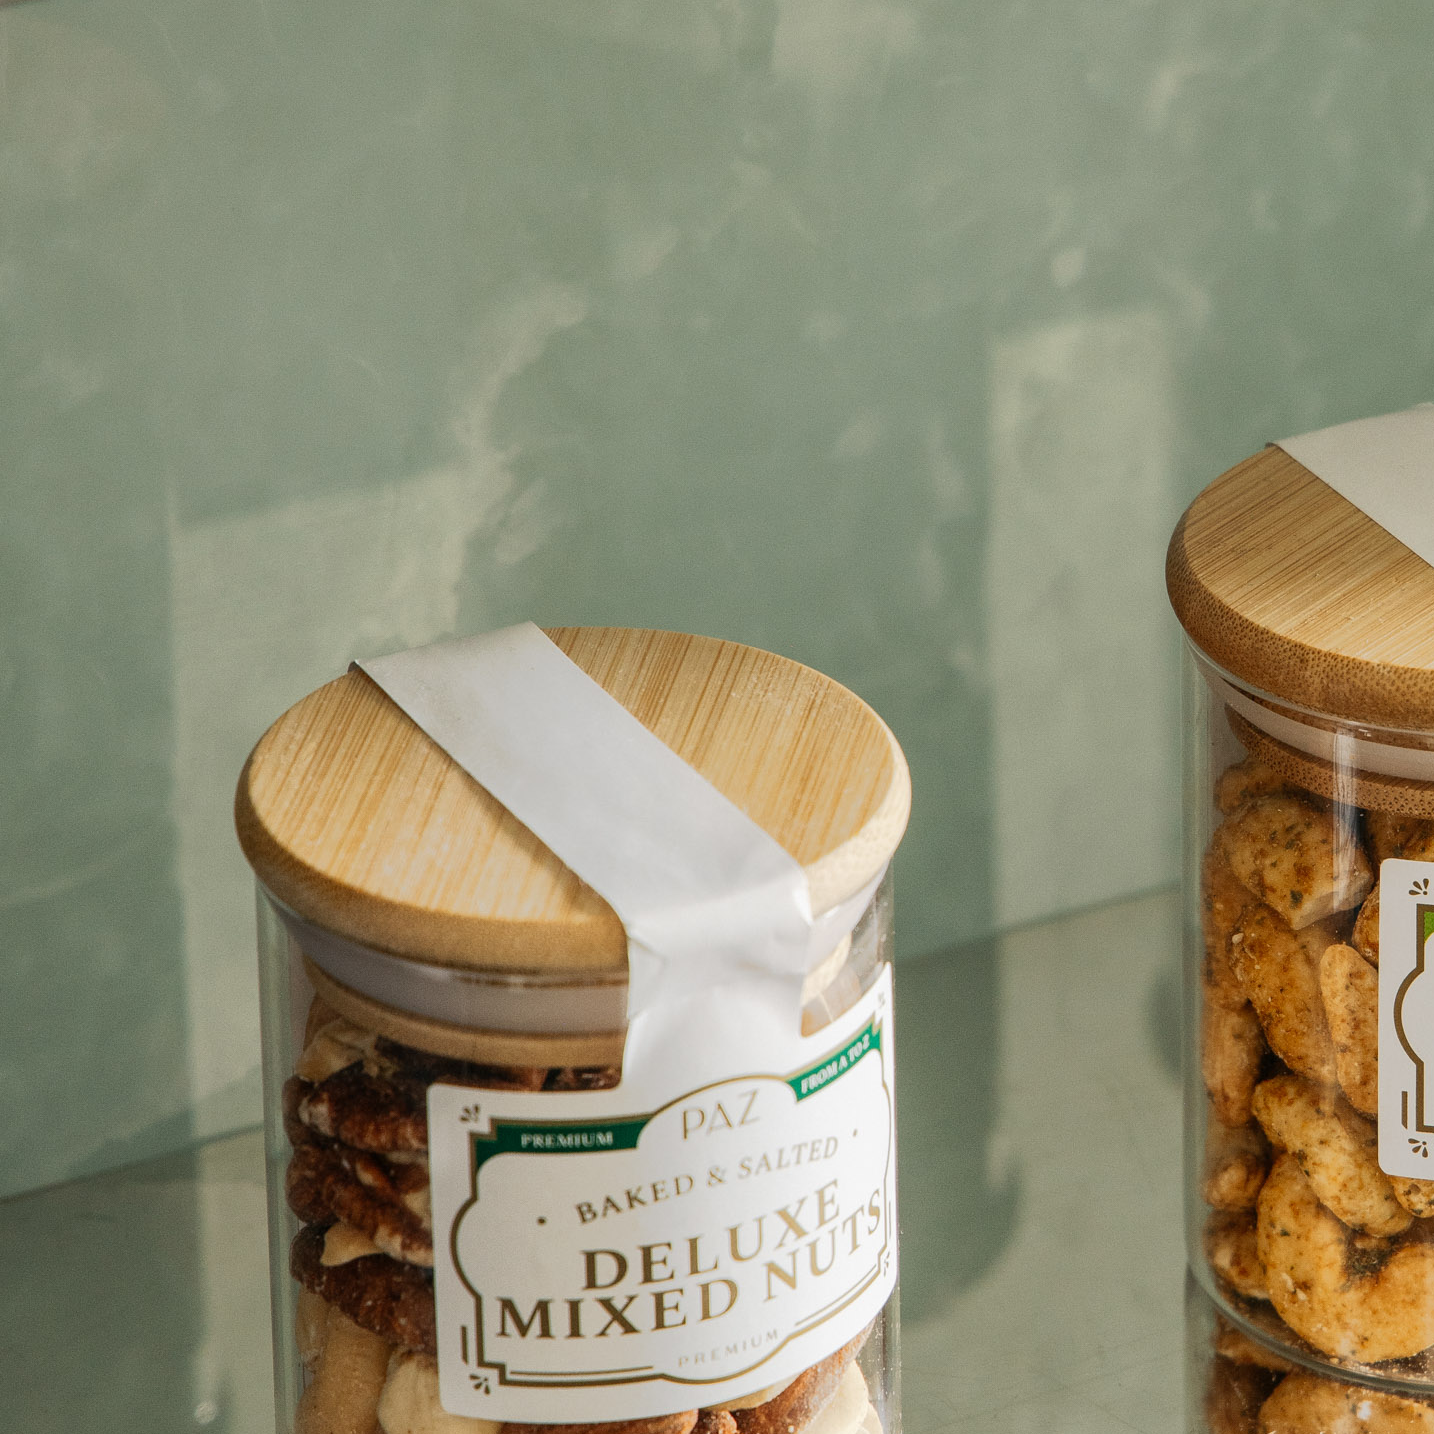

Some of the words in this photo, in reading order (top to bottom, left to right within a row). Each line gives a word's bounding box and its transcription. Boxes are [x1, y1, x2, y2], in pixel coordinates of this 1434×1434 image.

[800, 1062, 839, 1096] FROM
[520, 1131, 615, 1150] PREMIUM
[681, 1089, 761, 1141] PAZ
[575, 1174, 695, 1225] BAKED
[706, 1165, 728, 1188] &
[737, 1134, 838, 1181] SALTED
[580, 1178, 841, 1292] DELUXE
[495, 1277, 740, 1340] MIXED
[762, 1187, 882, 1303] NUTS
[678, 1328, 780, 1368] PREMIUM
